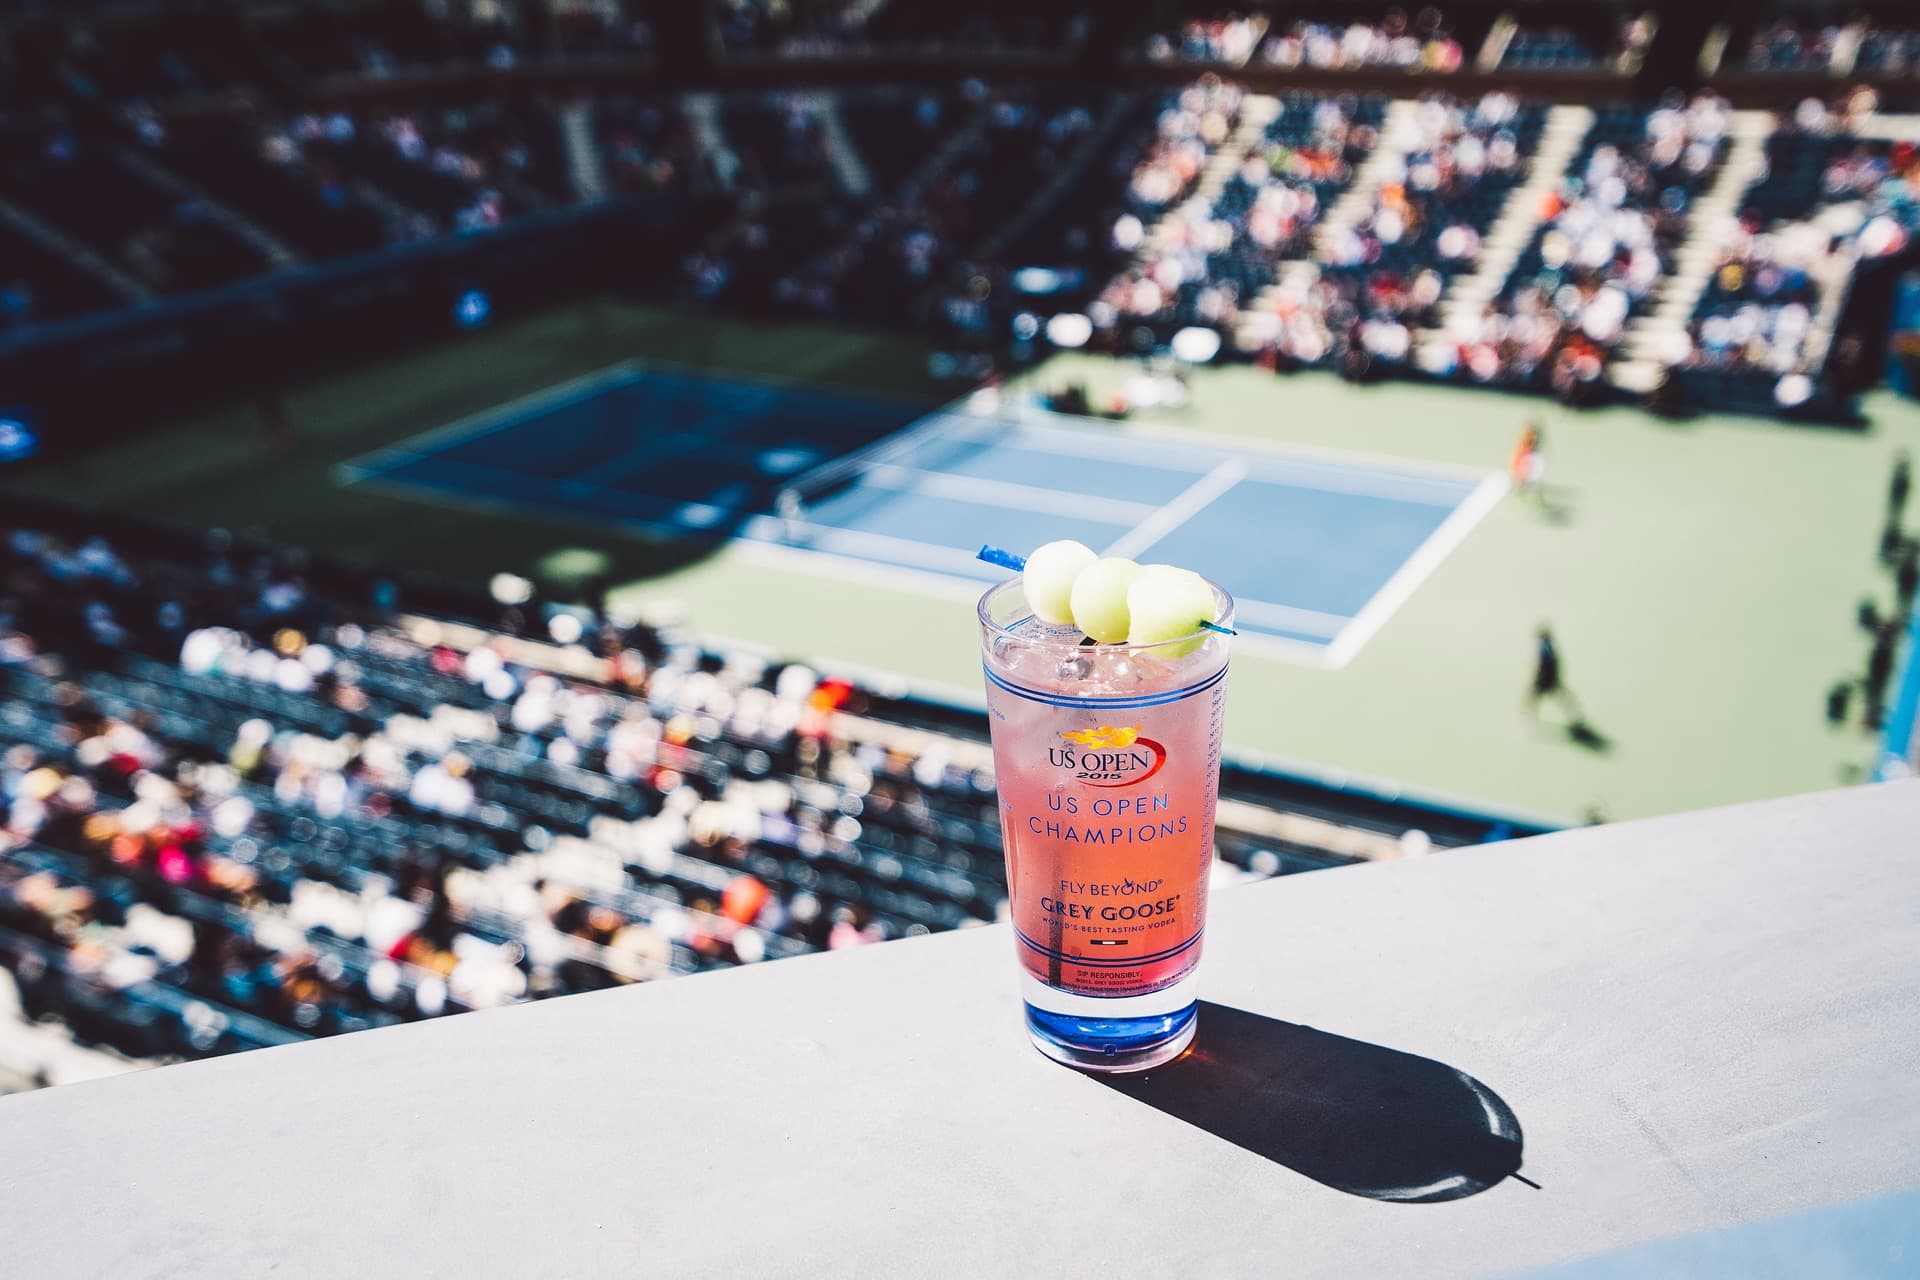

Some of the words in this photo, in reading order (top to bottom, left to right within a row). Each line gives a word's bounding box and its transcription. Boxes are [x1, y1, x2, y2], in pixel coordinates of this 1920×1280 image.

[1048, 748, 1075, 768] US
[1081, 751, 1150, 771] OPEN
[1076, 772, 1122, 780] 2015
[1048, 794, 1078, 814] US
[1093, 793, 1169, 816] OPEN
[1029, 816, 1188, 844] CHAMPIONS
[1061, 880, 1086, 894] FLY
[1041, 897, 1094, 919] GREY
[1081, 925, 1102, 933] BEST
[1106, 925, 1145, 934] TASTING
[1149, 918, 1176, 930] VODKA
